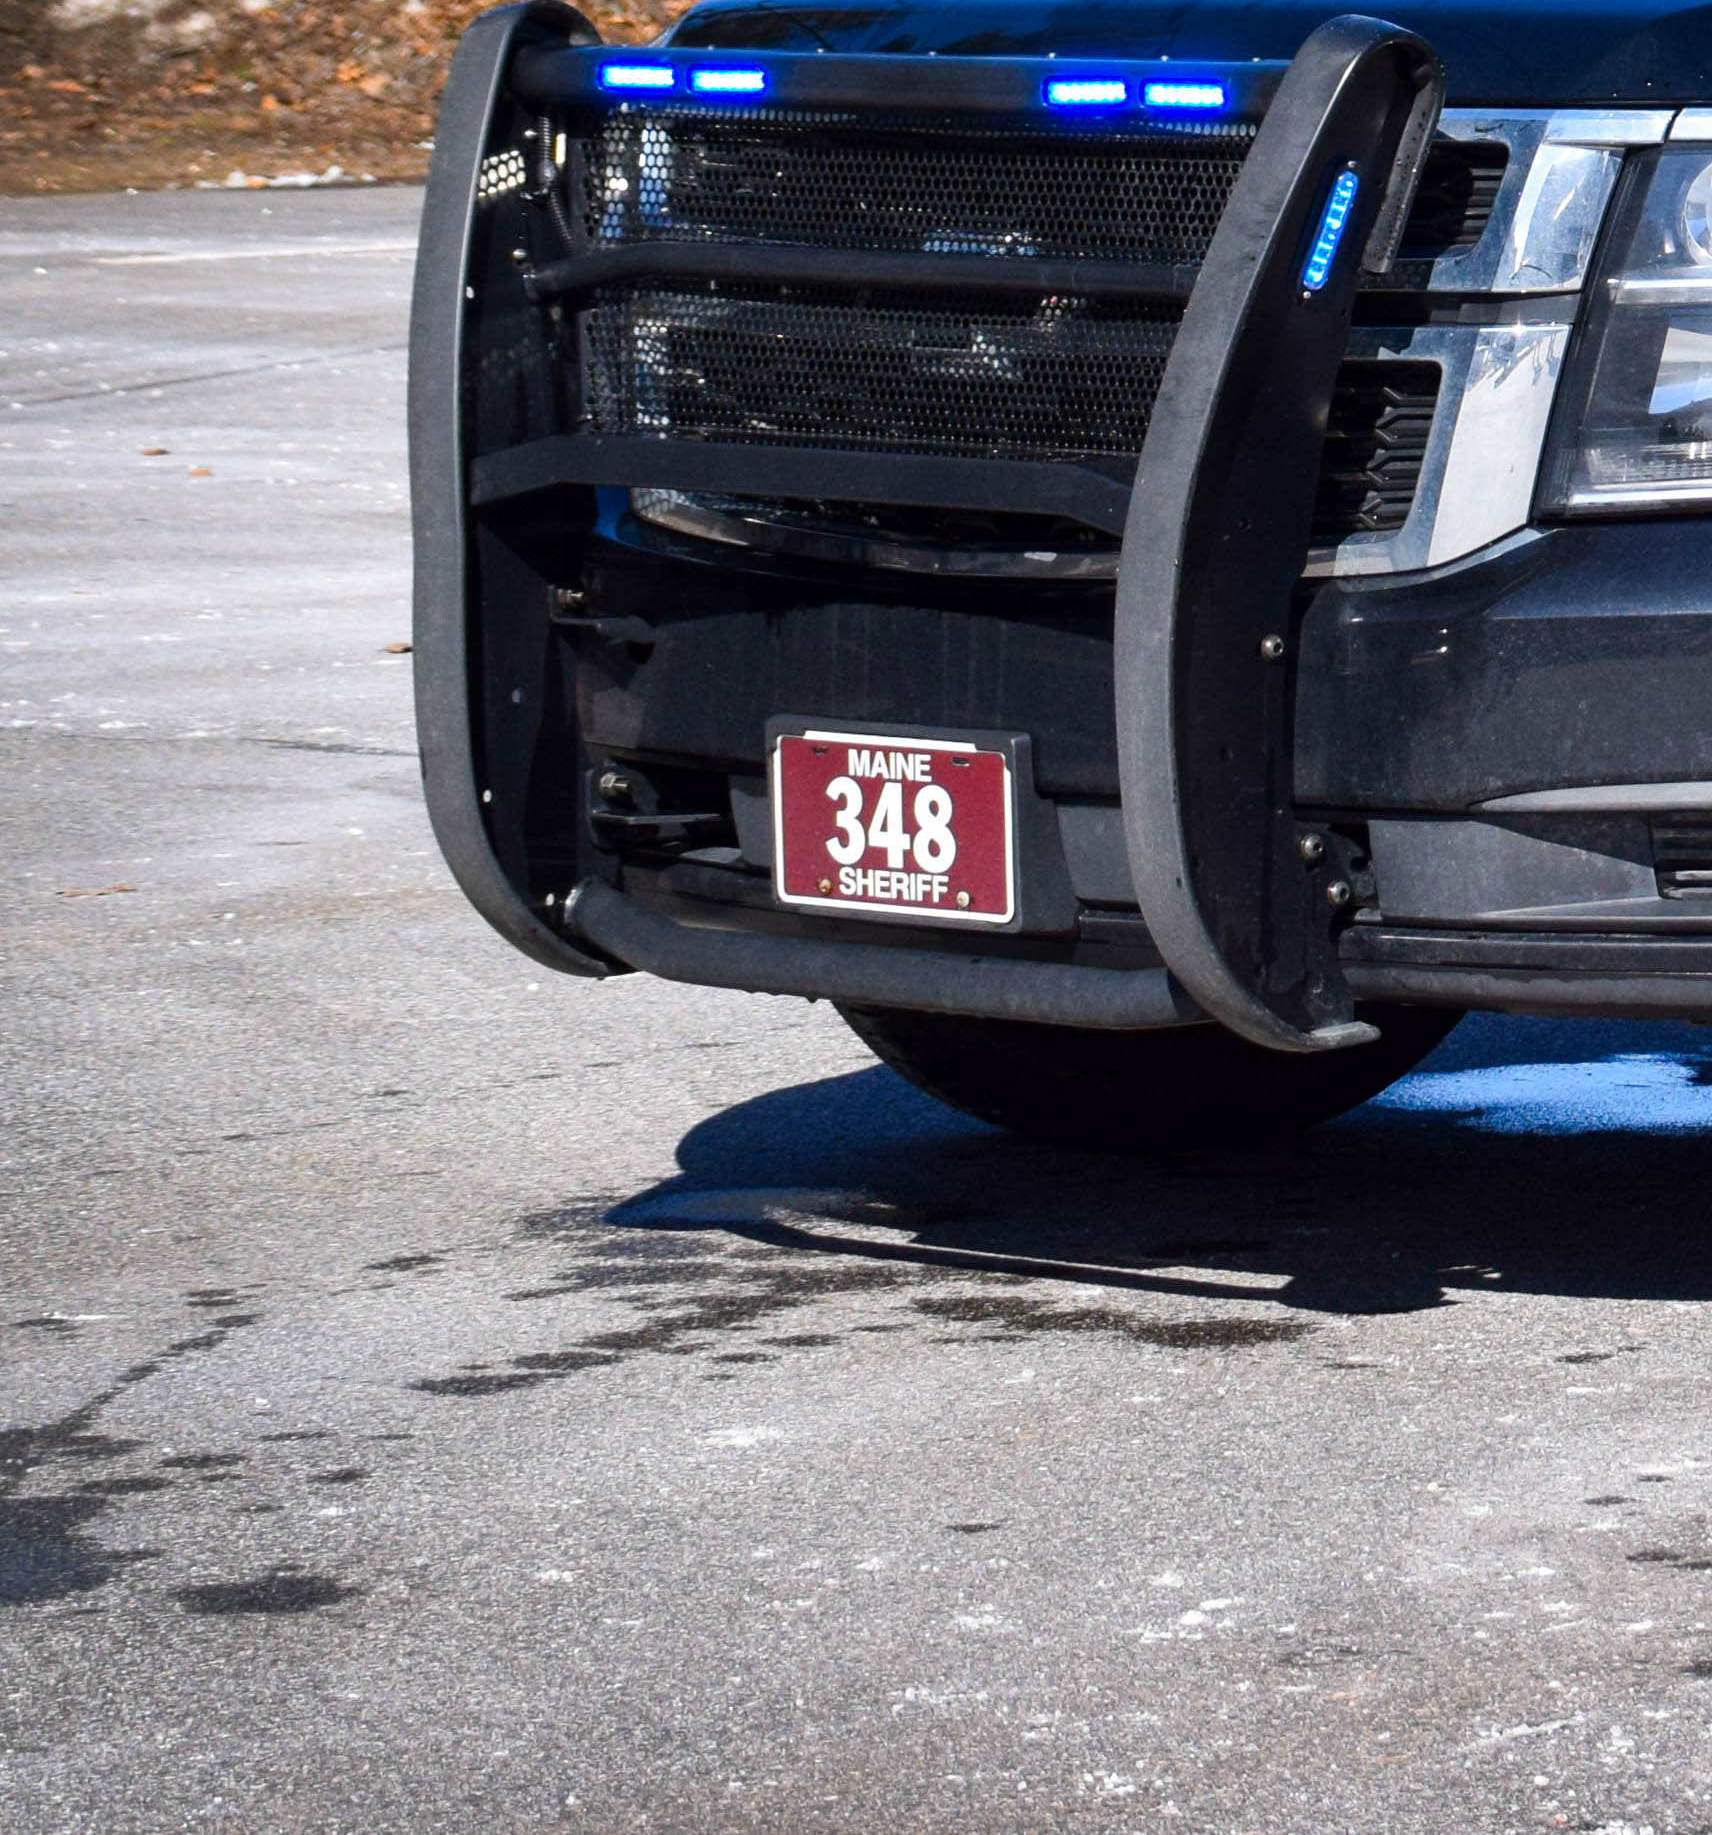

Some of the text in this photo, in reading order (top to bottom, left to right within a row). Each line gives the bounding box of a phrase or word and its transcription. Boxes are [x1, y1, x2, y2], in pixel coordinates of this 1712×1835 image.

[847, 748, 933, 783] MAINE
[824, 775, 957, 875] 348
[838, 866, 950, 904] SHERIFF
